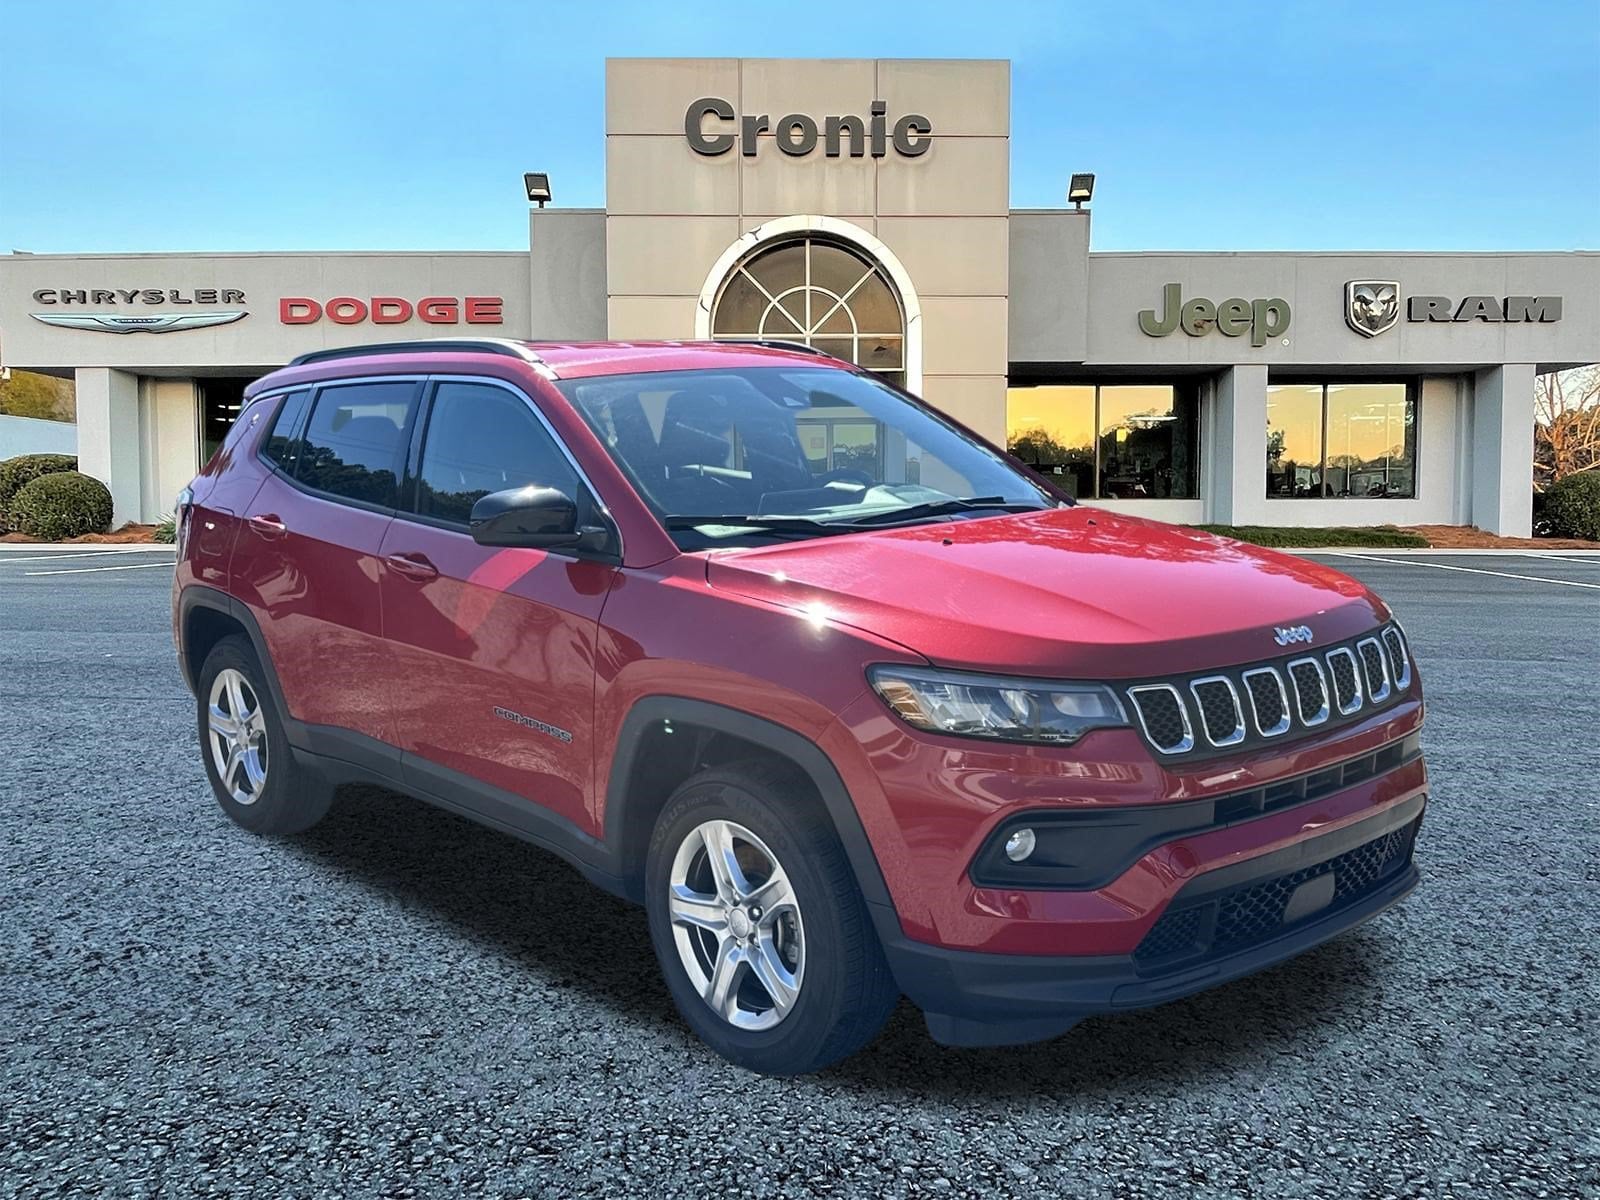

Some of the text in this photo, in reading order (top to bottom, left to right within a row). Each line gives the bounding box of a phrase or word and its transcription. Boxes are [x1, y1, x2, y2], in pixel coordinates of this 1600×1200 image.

[685, 97, 932, 158] Cronic
[32, 288, 246, 305] CHRYSLER
[1407, 296, 1563, 323] RAM
[279, 297, 504, 325] DODGE
[1138, 283, 1291, 348] Jeep
[1273, 625, 1314, 646] Jeep
[493, 705, 574, 744] COMPASS
